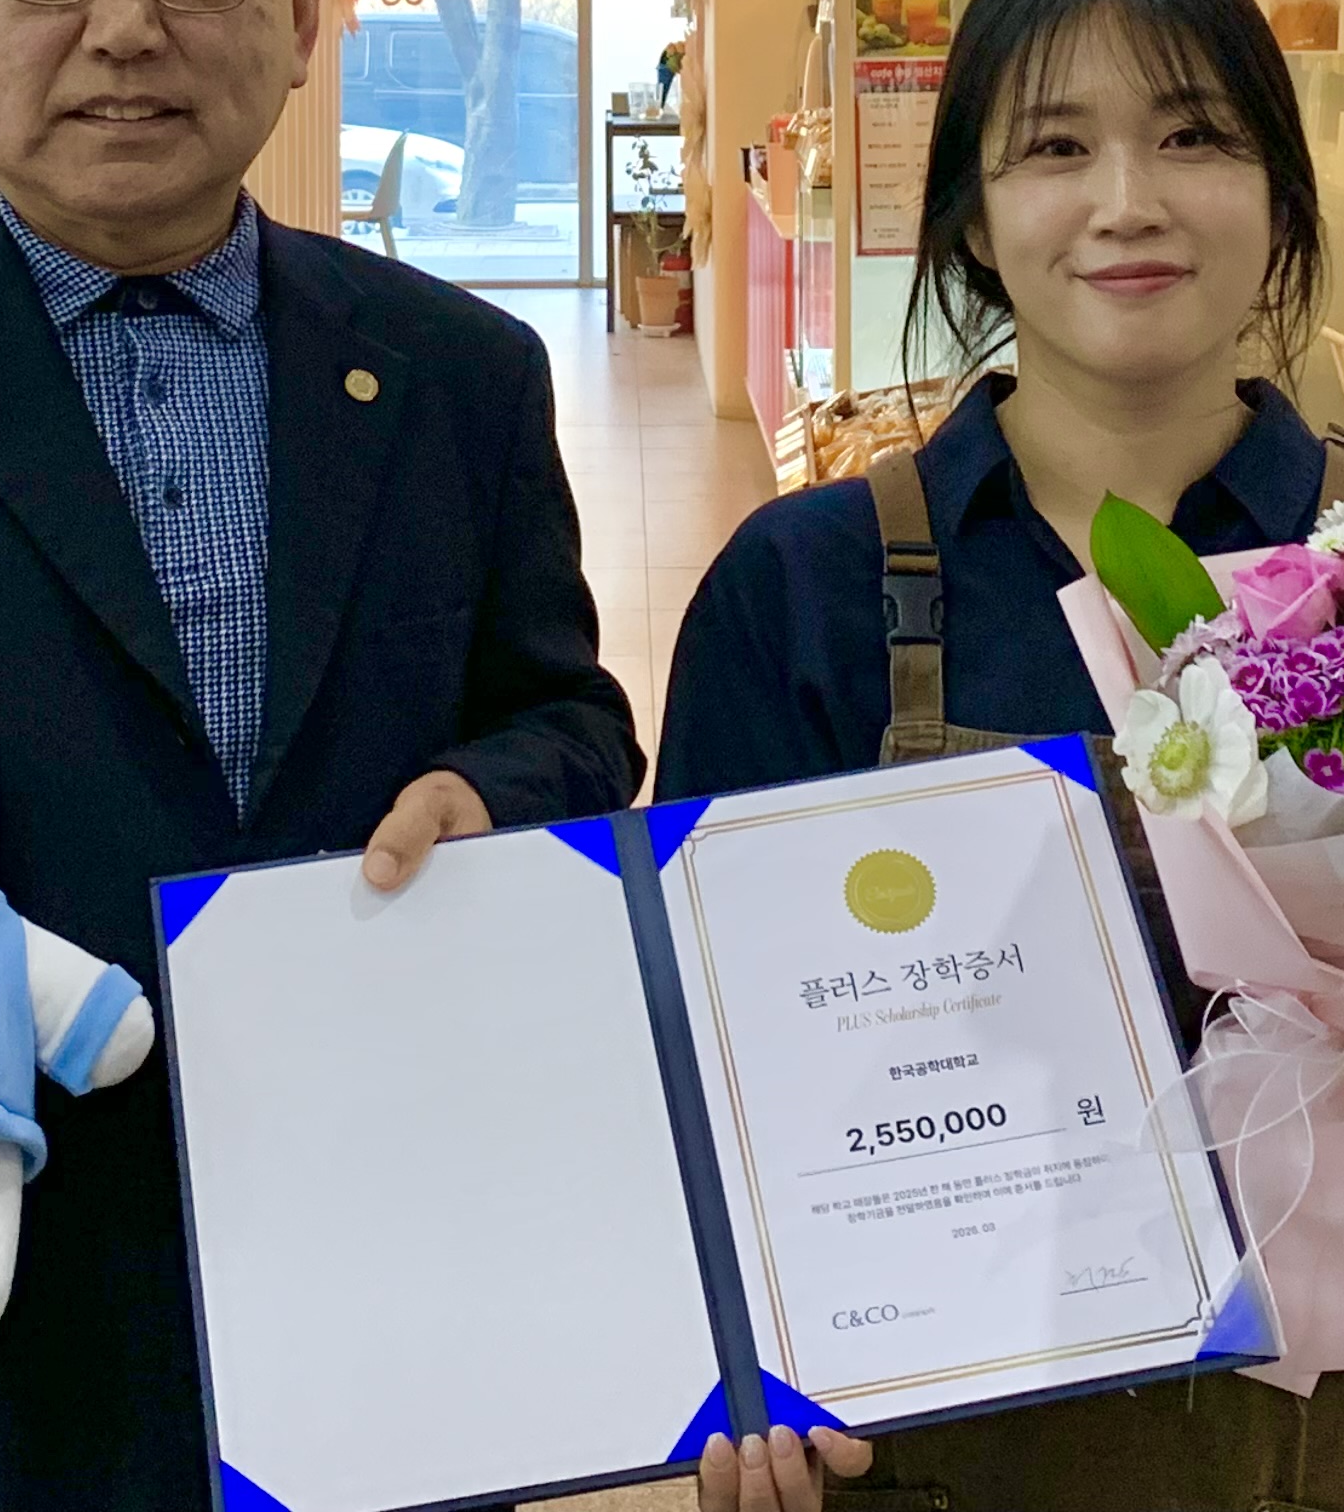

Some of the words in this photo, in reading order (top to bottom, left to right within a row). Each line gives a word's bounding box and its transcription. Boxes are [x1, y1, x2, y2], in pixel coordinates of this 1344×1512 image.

[799, 970, 892, 1009] 플러스
[900, 943, 1025, 991] 장학증서
[837, 1012, 872, 1032] PLUS
[875, 1001, 940, 1024] Scholarship
[943, 993, 1003, 1014] Certificate
[889, 1053, 980, 1081] 한국공학대학교
[846, 1103, 1008, 1155] 2,550,000
[1076, 1094, 1106, 1126] 원
[893, 1186, 929, 1202] 2025년
[974, 1174, 1002, 1187] 플러스
[1044, 1173, 1082, 1188] 드립니다
[832, 1304, 900, 1331] C&CO
